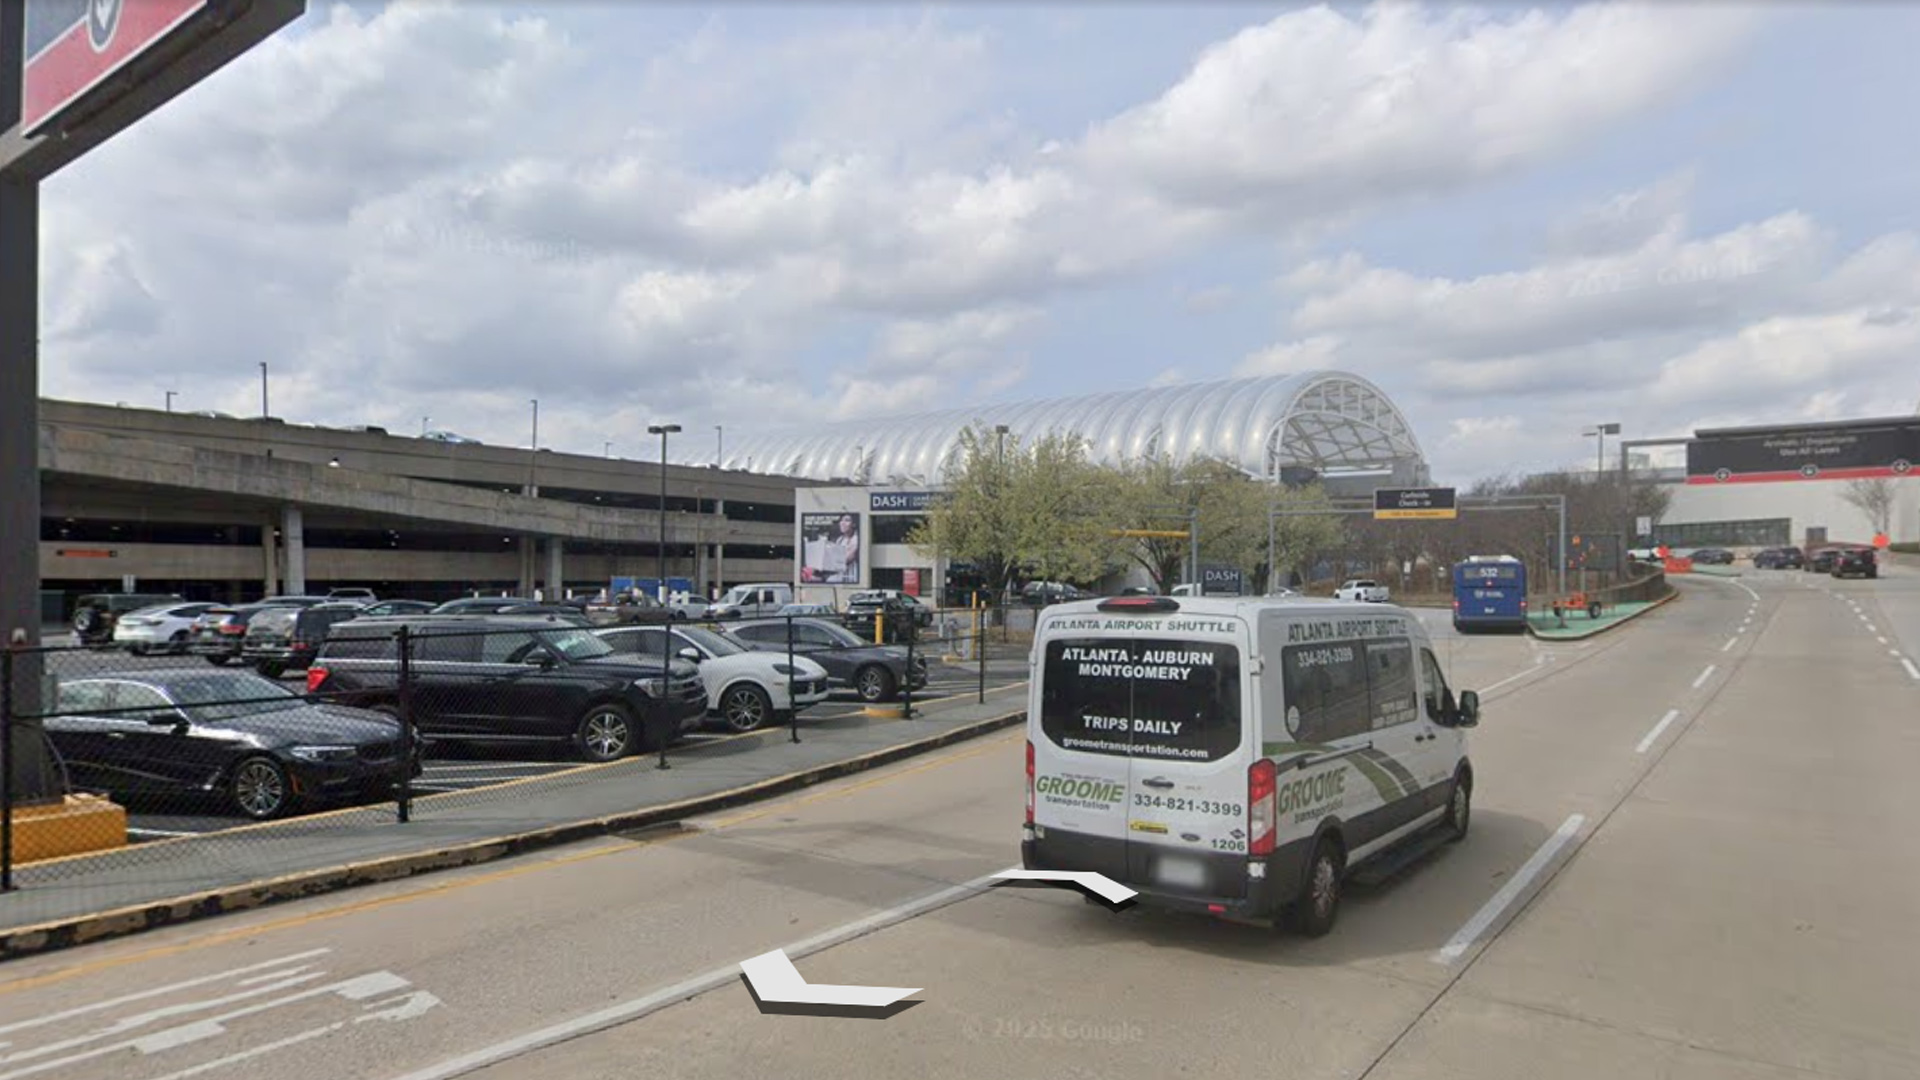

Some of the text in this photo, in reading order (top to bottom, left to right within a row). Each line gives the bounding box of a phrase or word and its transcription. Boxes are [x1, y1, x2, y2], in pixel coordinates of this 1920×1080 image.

[872, 495, 908, 508] DASH
[1205, 569, 1240, 581] DASH
[1480, 566, 1499, 578] 532
[1049, 619, 1236, 633] ATLANTA AIRPORT SHUTTLE
[1288, 618, 1408, 643] ATLANTA AIRPORT SHUTTLE
[1061, 647, 1129, 662] ATLANTA
[1142, 650, 1214, 666] AUBURN
[1078, 663, 1192, 681] MONTGOMERY
[1082, 715, 1183, 735] TRIPS DAILY
[1062, 736, 1210, 759] groometransportation.com
[1036, 774, 1126, 804] GROOME
[1277, 765, 1348, 816] GROOME
[1045, 795, 1111, 811] transportation
[1133, 793, 1243, 817] 334-821-3399
[1210, 838, 1246, 852] 1206
